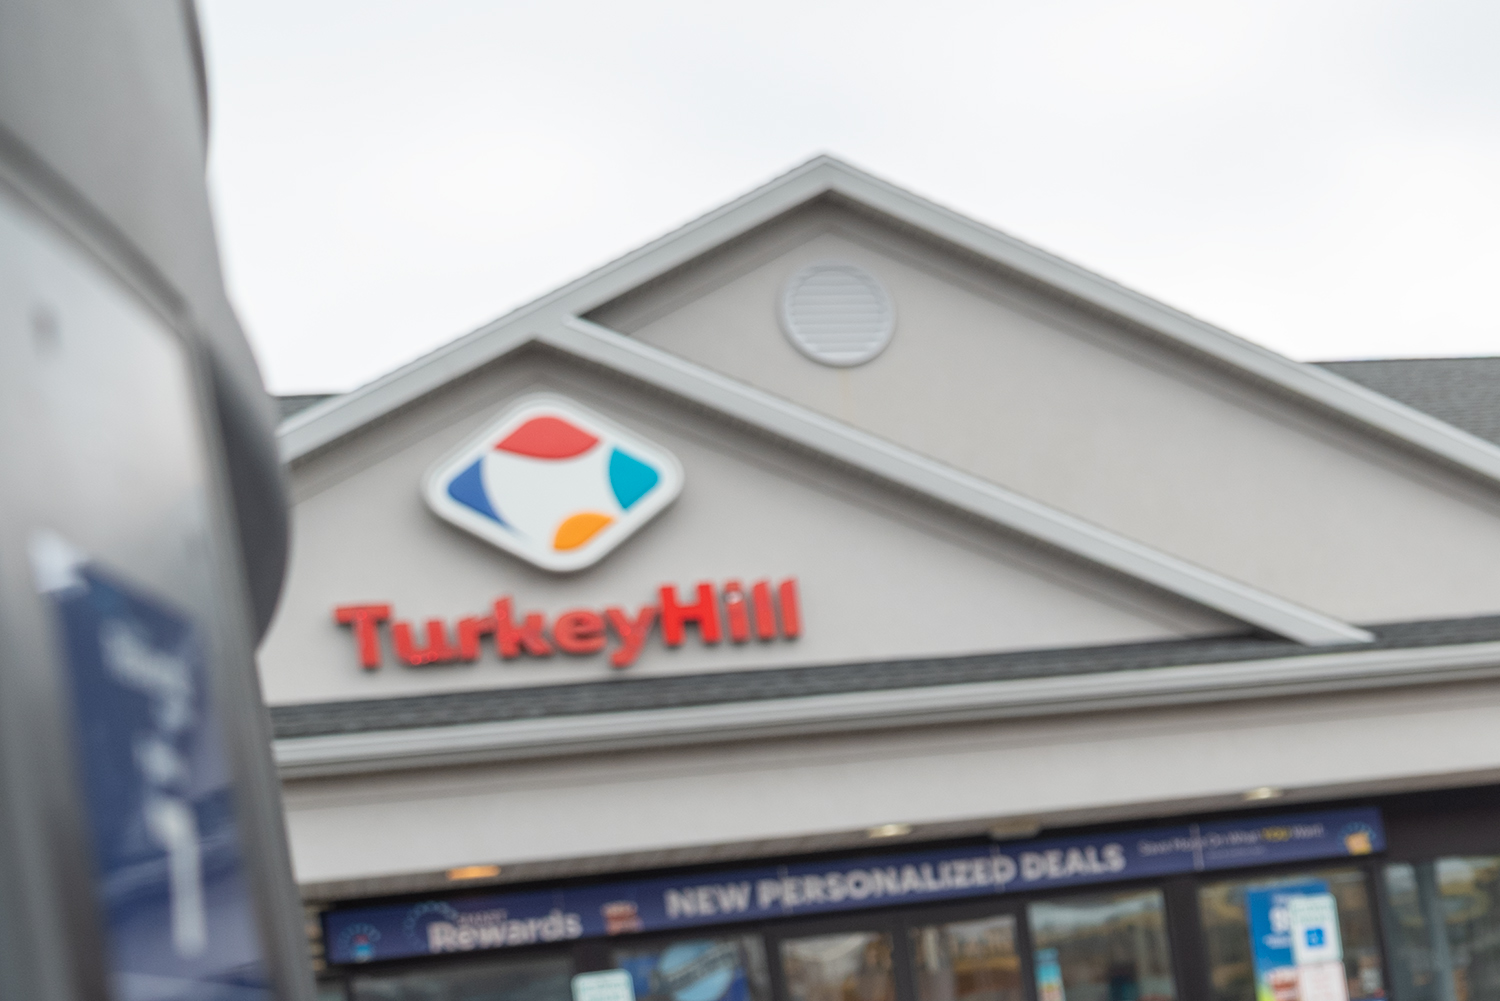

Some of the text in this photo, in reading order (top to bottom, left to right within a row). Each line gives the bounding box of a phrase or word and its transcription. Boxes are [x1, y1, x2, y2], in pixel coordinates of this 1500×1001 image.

[664, 842, 1127, 919] NEW PERSONALIZED DEALS
[425, 908, 584, 954] Rewards
